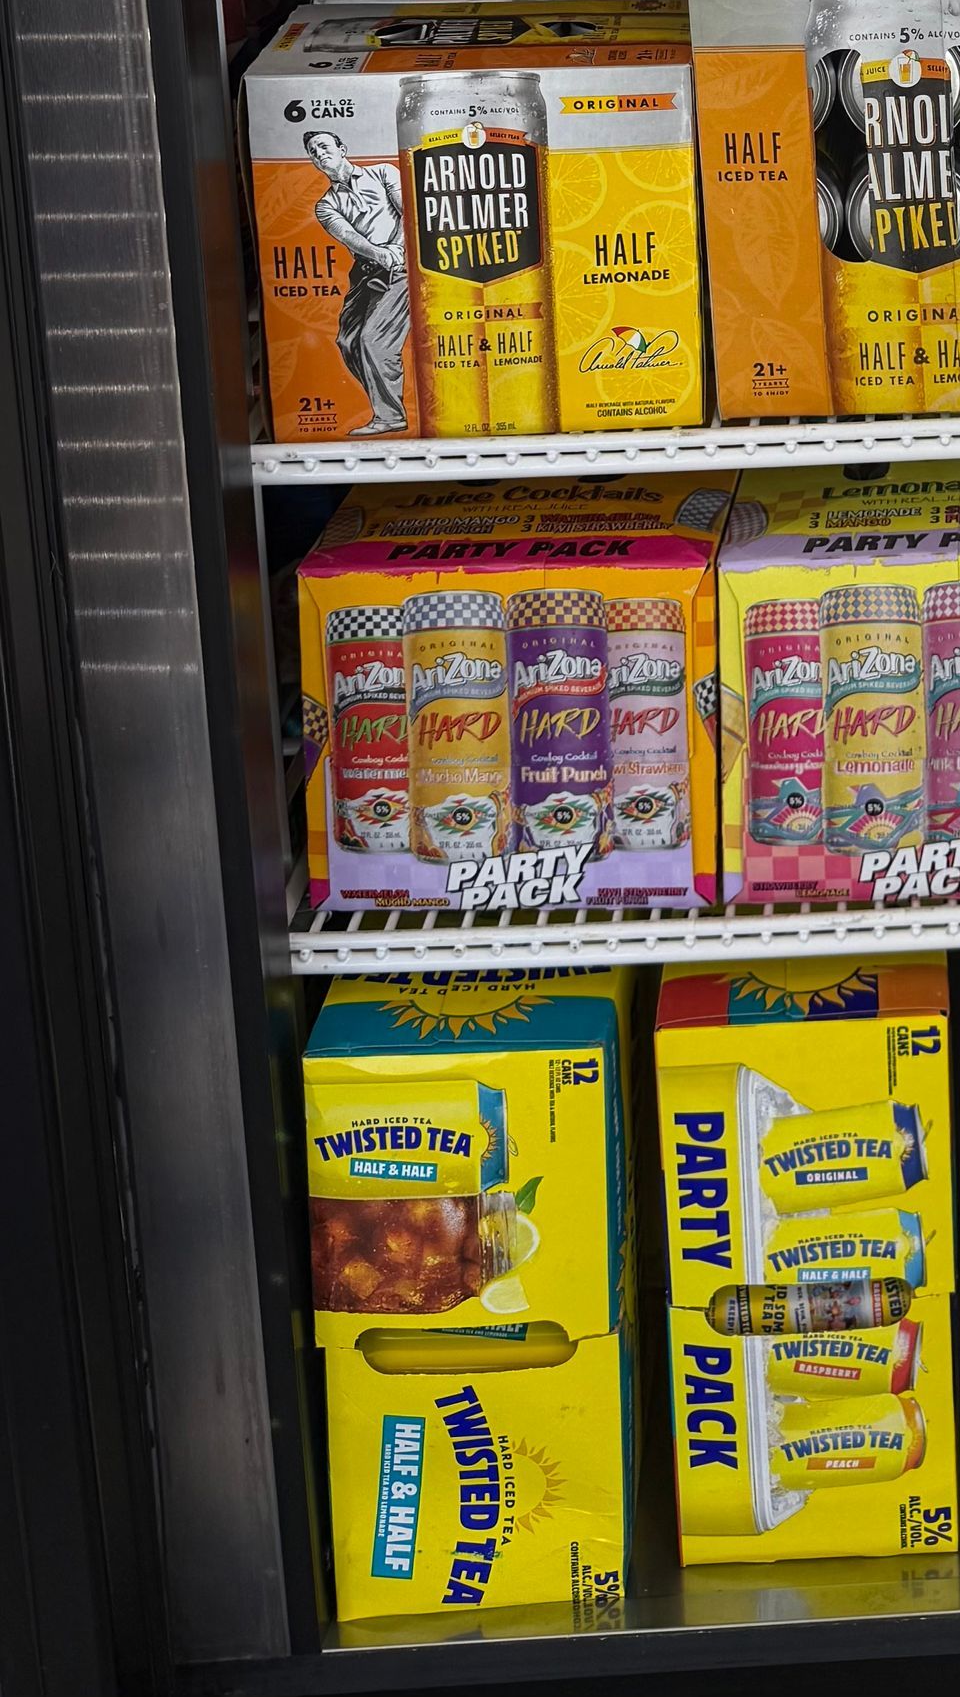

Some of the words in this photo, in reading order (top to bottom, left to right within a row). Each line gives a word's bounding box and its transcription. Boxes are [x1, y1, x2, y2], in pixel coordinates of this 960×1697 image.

[284, 101, 306, 122] 6
[311, 106, 354, 118] CANS
[469, 106, 487, 117] 5%
[573, 96, 659, 111] ORIGINAL
[724, 132, 781, 165] HALF
[423, 152, 527, 193] ARNOLD
[718, 171, 756, 181] ICED
[759, 170, 788, 181] TEA
[426, 192, 529, 232] PALMER
[274, 246, 338, 279] HALF
[437, 230, 521, 270] SPIKED
[595, 232, 657, 266] HALF
[274, 285, 308, 297] ICED
[312, 284, 341, 297] TEA
[584, 269, 669, 284] LEMONADE
[300, 397, 335, 412] 21+
[387, 542, 519, 561] PARTY
[528, 540, 635, 558] PACK
[802, 533, 929, 553] PARTY
[514, 650, 601, 698] AriZona
[828, 646, 916, 695] AriZona
[520, 708, 600, 748] HARD
[834, 705, 916, 745] HARD
[521, 767, 558, 783] Fruit
[562, 766, 607, 781] Punch
[447, 842, 594, 893] PARTY
[460, 873, 585, 910] PACK
[572, 1058, 599, 1085] 12
[314, 1126, 422, 1161] TWISTED
[427, 1129, 472, 1157] TEA
[764, 1139, 851, 1177] TWISTED
[855, 1139, 892, 1159] TEA
[354, 1162, 386, 1174] HALF
[389, 1164, 399, 1175] &
[401, 1165, 434, 1177] HALF
[806, 1171, 858, 1182] ORIGINAL
[674, 1111, 732, 1269] PARTY
[799, 1364, 858, 1378] RASPBERRY
[681, 1343, 738, 1469] PACK
[434, 1385, 500, 1531] TWISTED
[825, 1459, 859, 1469] PEACH
[923, 1506, 952, 1546] 5%
[441, 1538, 497, 1604] TEA
